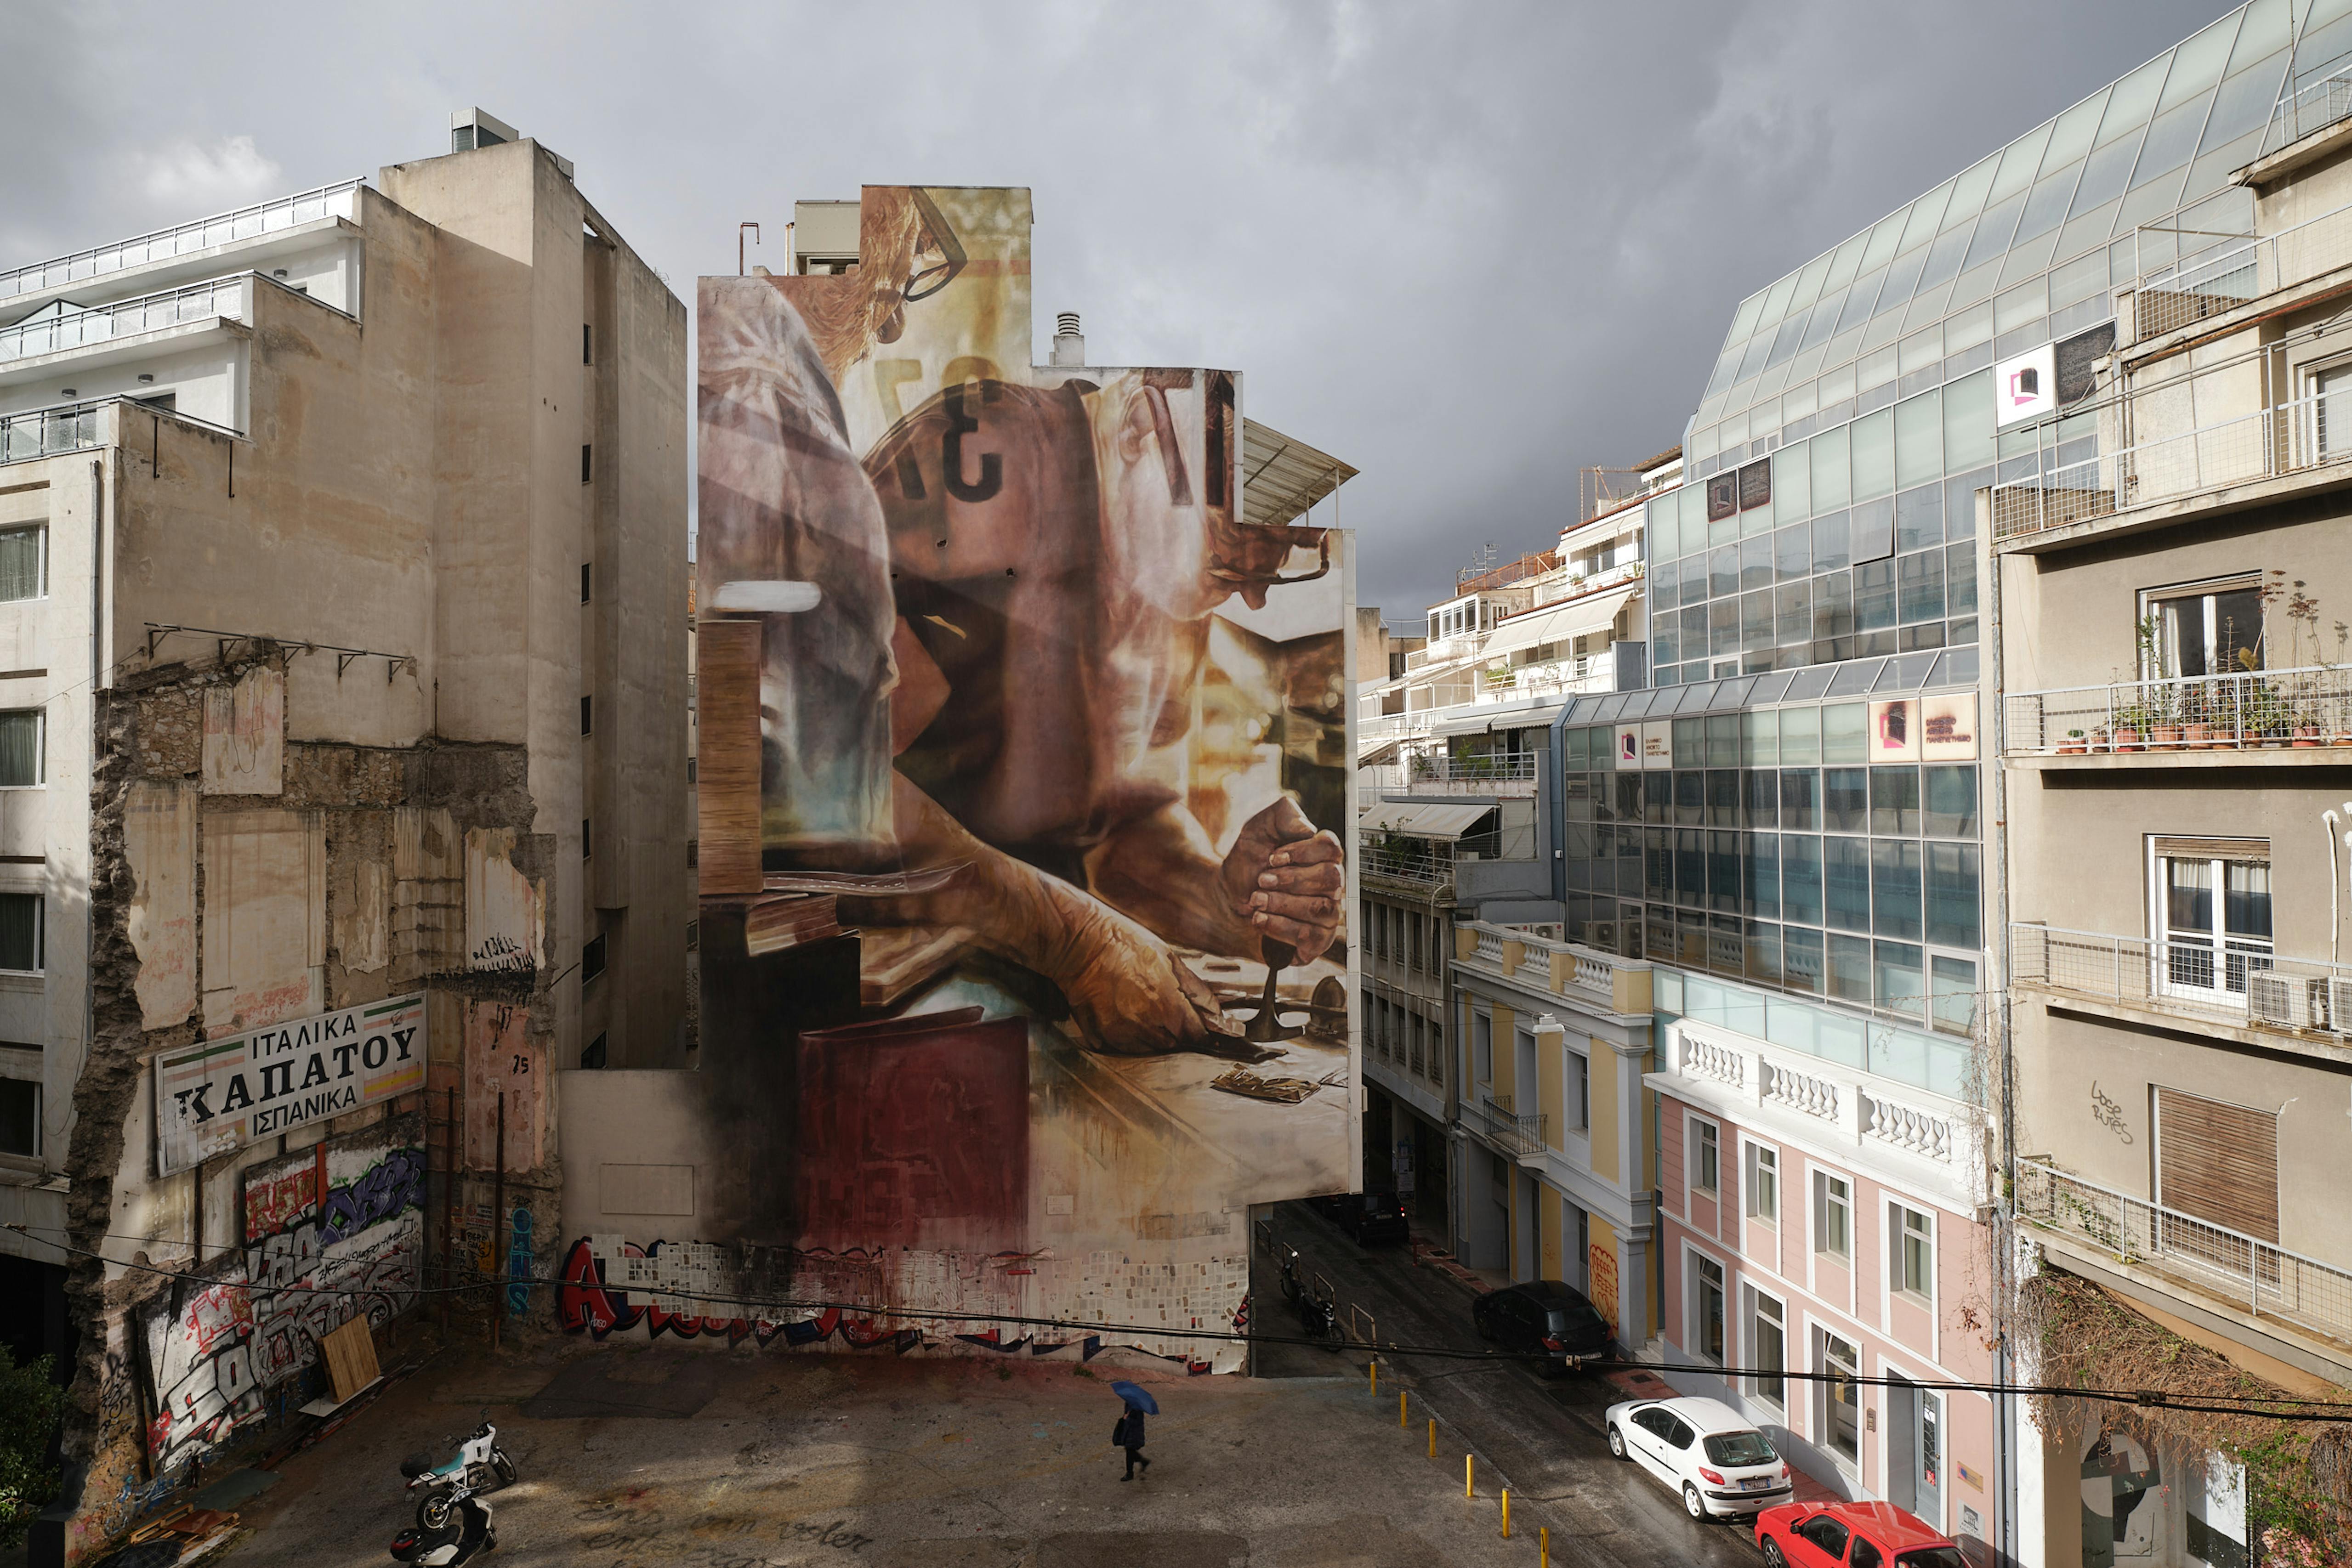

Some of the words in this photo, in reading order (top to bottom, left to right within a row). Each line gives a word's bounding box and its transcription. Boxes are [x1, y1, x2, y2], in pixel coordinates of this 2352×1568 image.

[253, 1014, 357, 1059] ΙΤΑΛΙΚΑ
[174, 1026, 417, 1124] ΚΑΠΑΤΟΥ
[254, 1085, 357, 1137] ΙΣΠΑΝΙΚΑ
